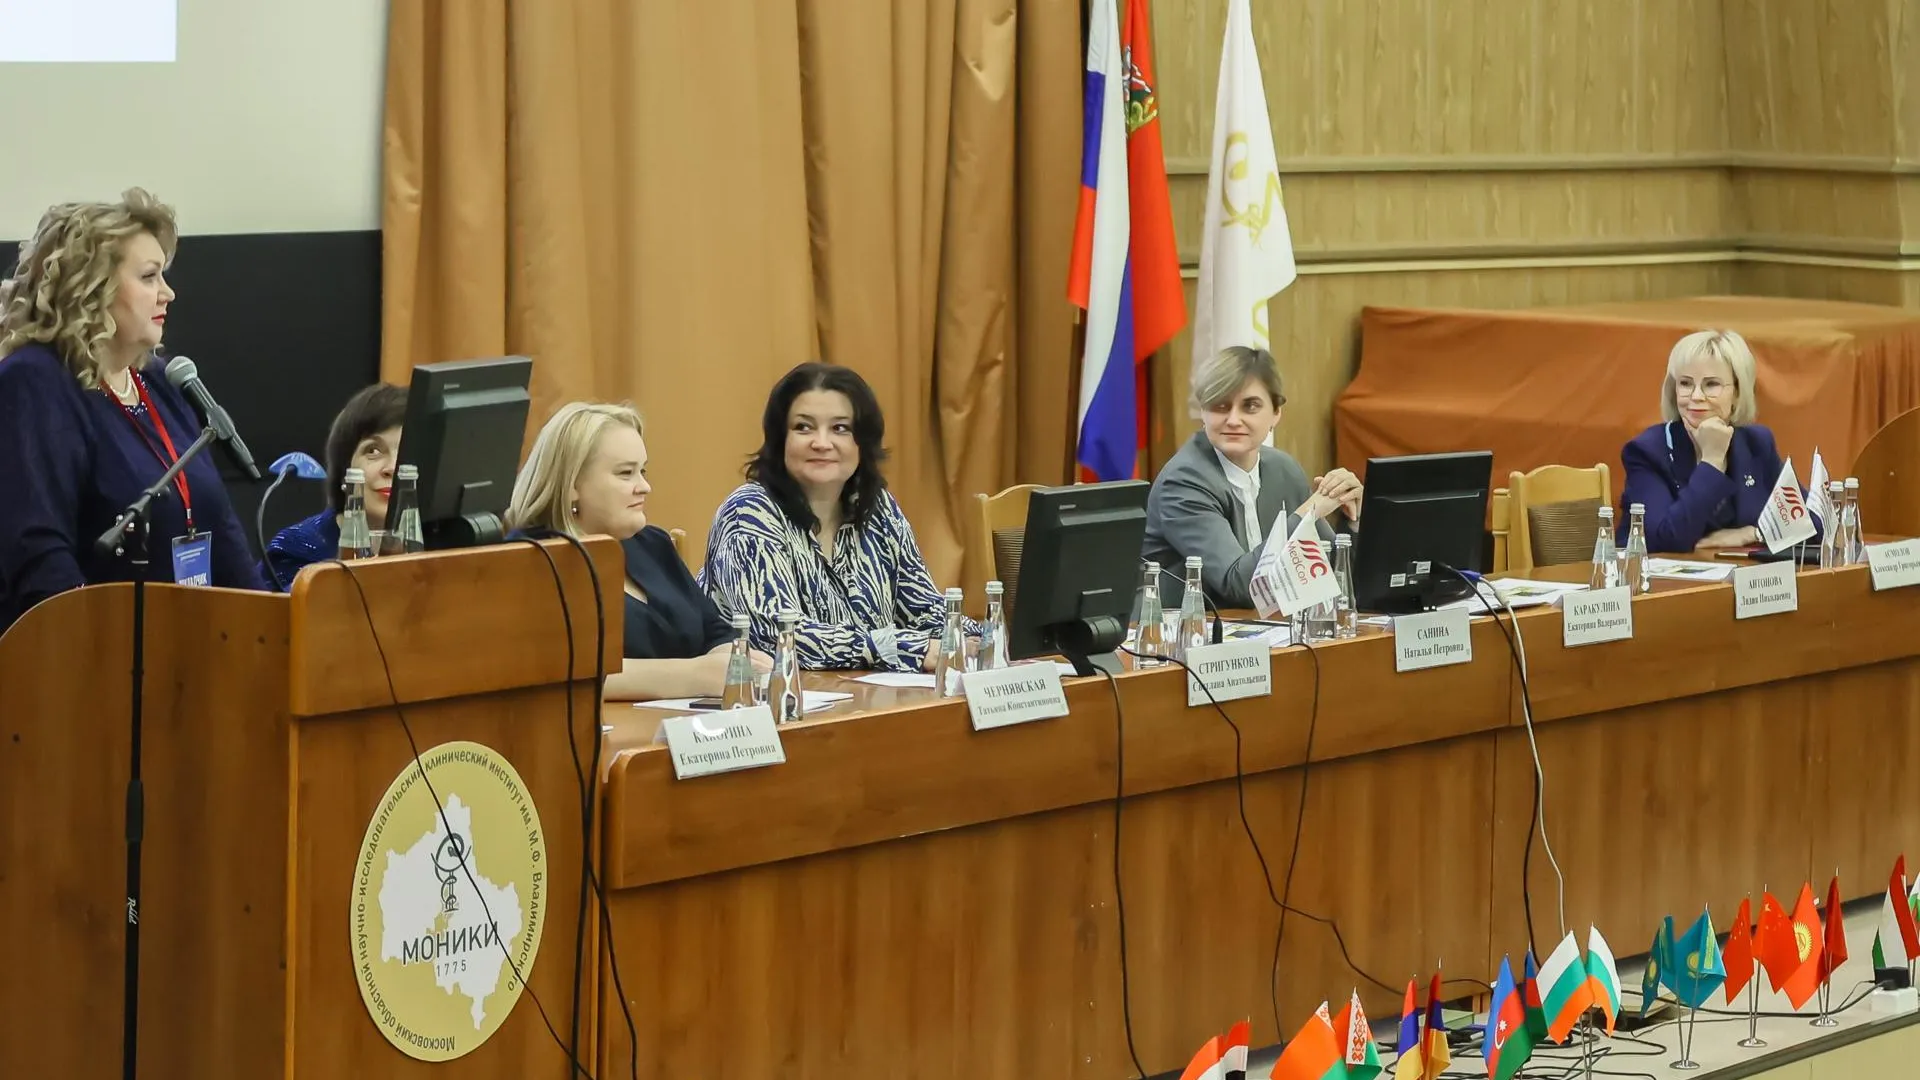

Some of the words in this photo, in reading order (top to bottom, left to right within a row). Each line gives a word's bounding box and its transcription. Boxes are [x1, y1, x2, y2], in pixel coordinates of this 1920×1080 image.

[1287, 540, 1308, 585] MedCon
[1749, 576, 1783, 588] АНТОНОВА
[1573, 601, 1620, 616] КАРАКУЛИНА
[1417, 626, 1450, 640] САНИНА
[1567, 622, 1596, 632] Екатерина
[1597, 618, 1628, 629] Валерьевна
[1404, 647, 1432, 659] Наталья
[1433, 643, 1464, 656] Петровна
[1198, 656, 1260, 675] СТРИГУНКОВА
[983, 678, 1047, 698] ЧЕРНЯВСКАЯ
[1192, 680, 1225, 692] Свтлана
[1226, 674, 1267, 687] Анатольевна
[977, 705, 1006, 716] Татьяна
[1007, 697, 1061, 711] Константиновна
[425, 750, 488, 772] клинический
[679, 751, 731, 766] Екатерина
[731, 743, 777, 759] Петровна
[489, 762, 523, 805] институт
[507, 872, 542, 991] Владимирского
[402, 921, 498, 965] МОНИКИ
[437, 959, 467, 977] 1775
[361, 963, 396, 1028] областной
[395, 1022, 455, 1051] Московский
